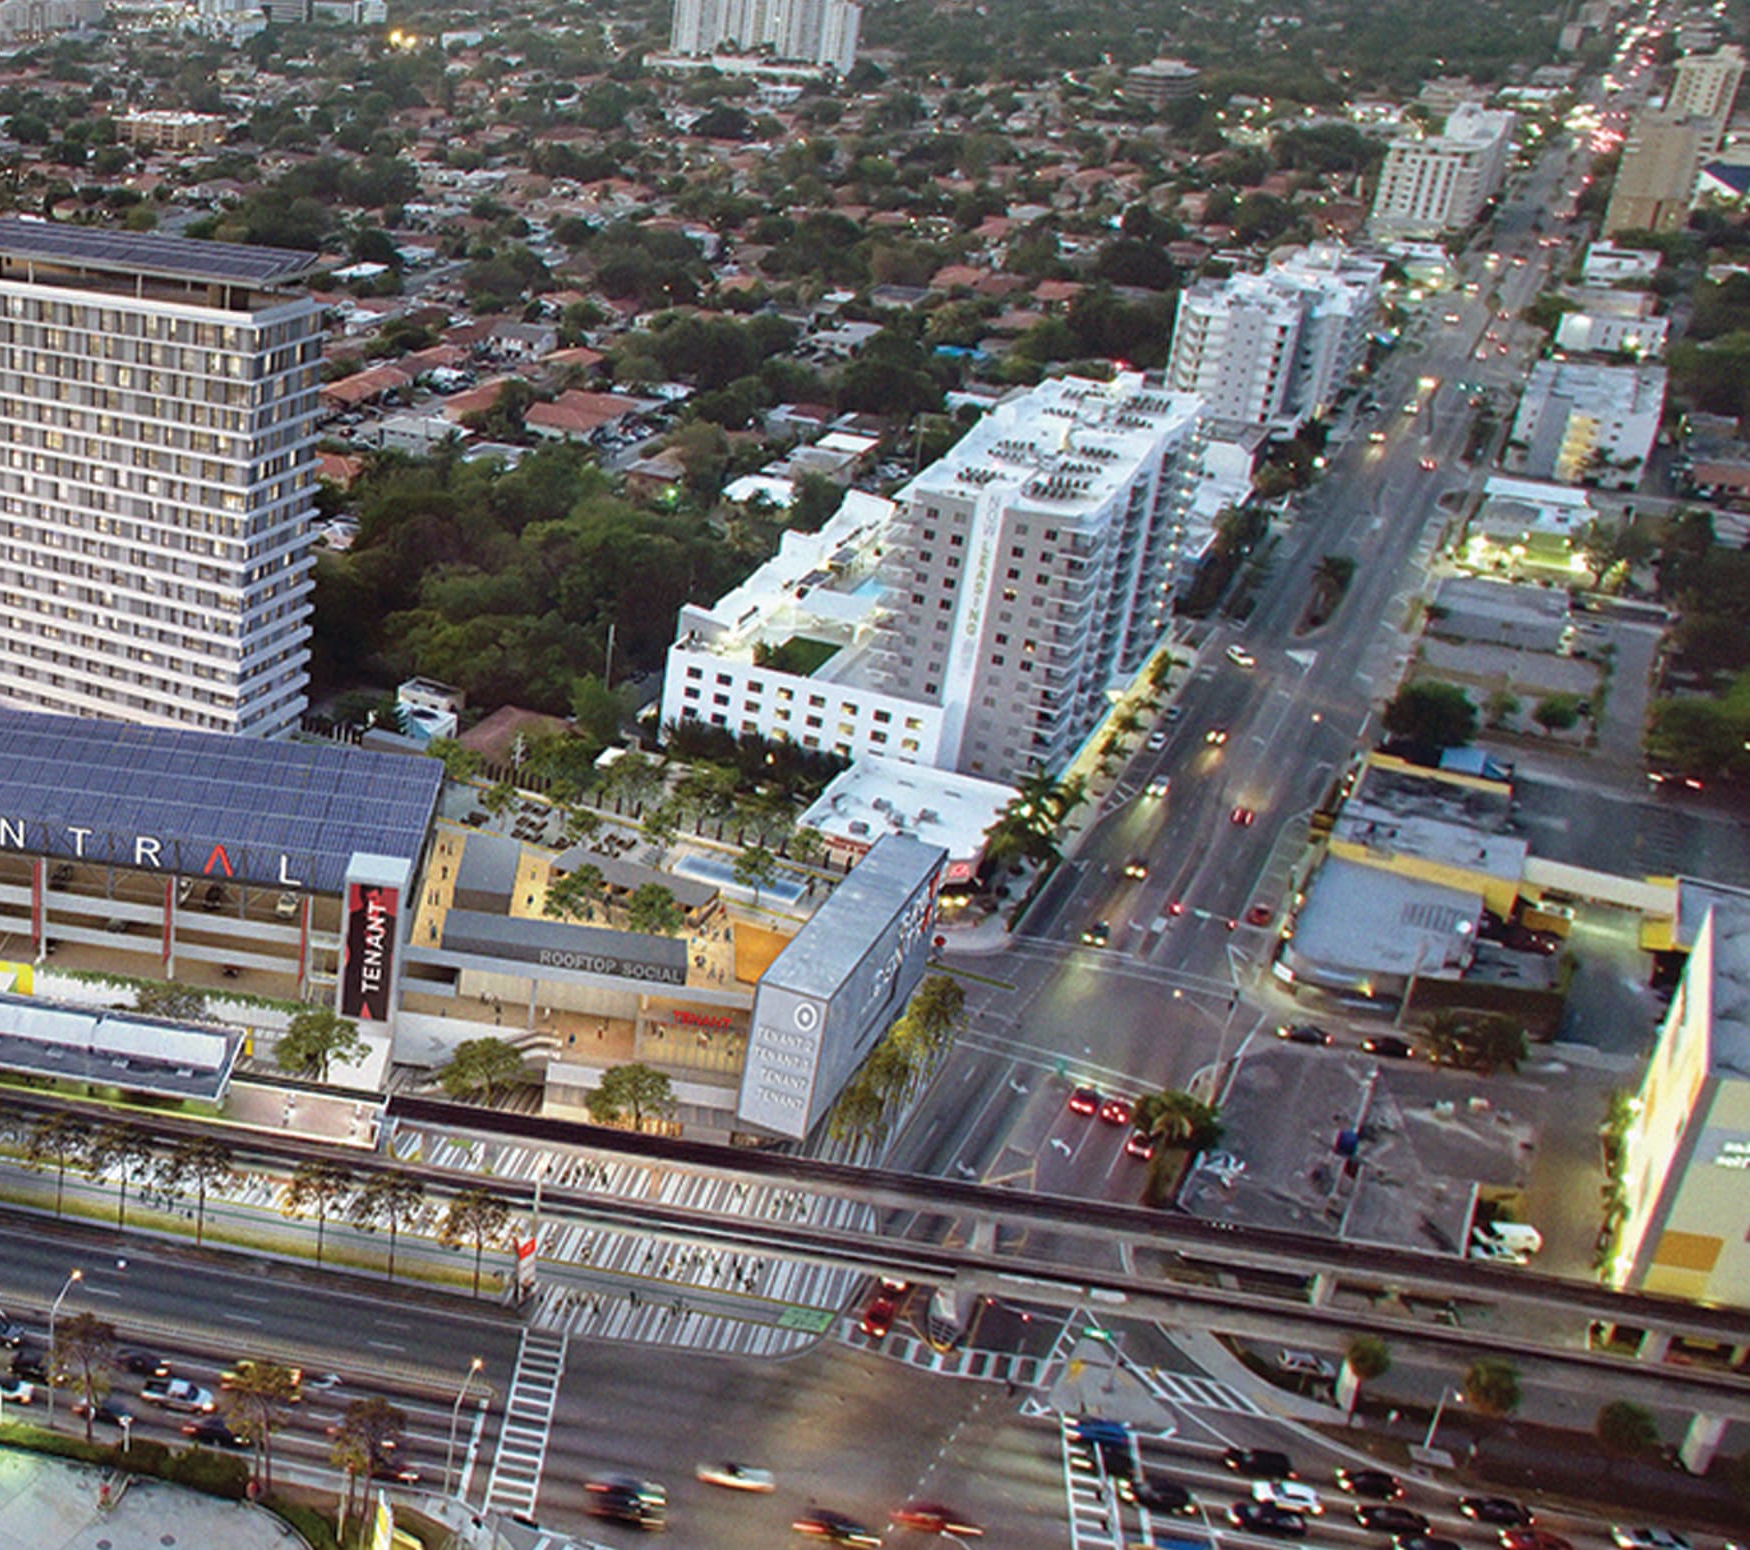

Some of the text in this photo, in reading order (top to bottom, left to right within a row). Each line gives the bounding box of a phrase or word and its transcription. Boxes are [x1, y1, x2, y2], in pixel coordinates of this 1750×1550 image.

[965, 540, 990, 636] LEASING
[361, 900, 387, 993] TENANT
[539, 950, 683, 984] ROOFTOP SOCIAL
[672, 1010, 732, 1030] TENANT
[757, 1027, 803, 1047] TENANT
[761, 1067, 807, 1089] TENANT
[758, 1086, 803, 1108] TENANT
